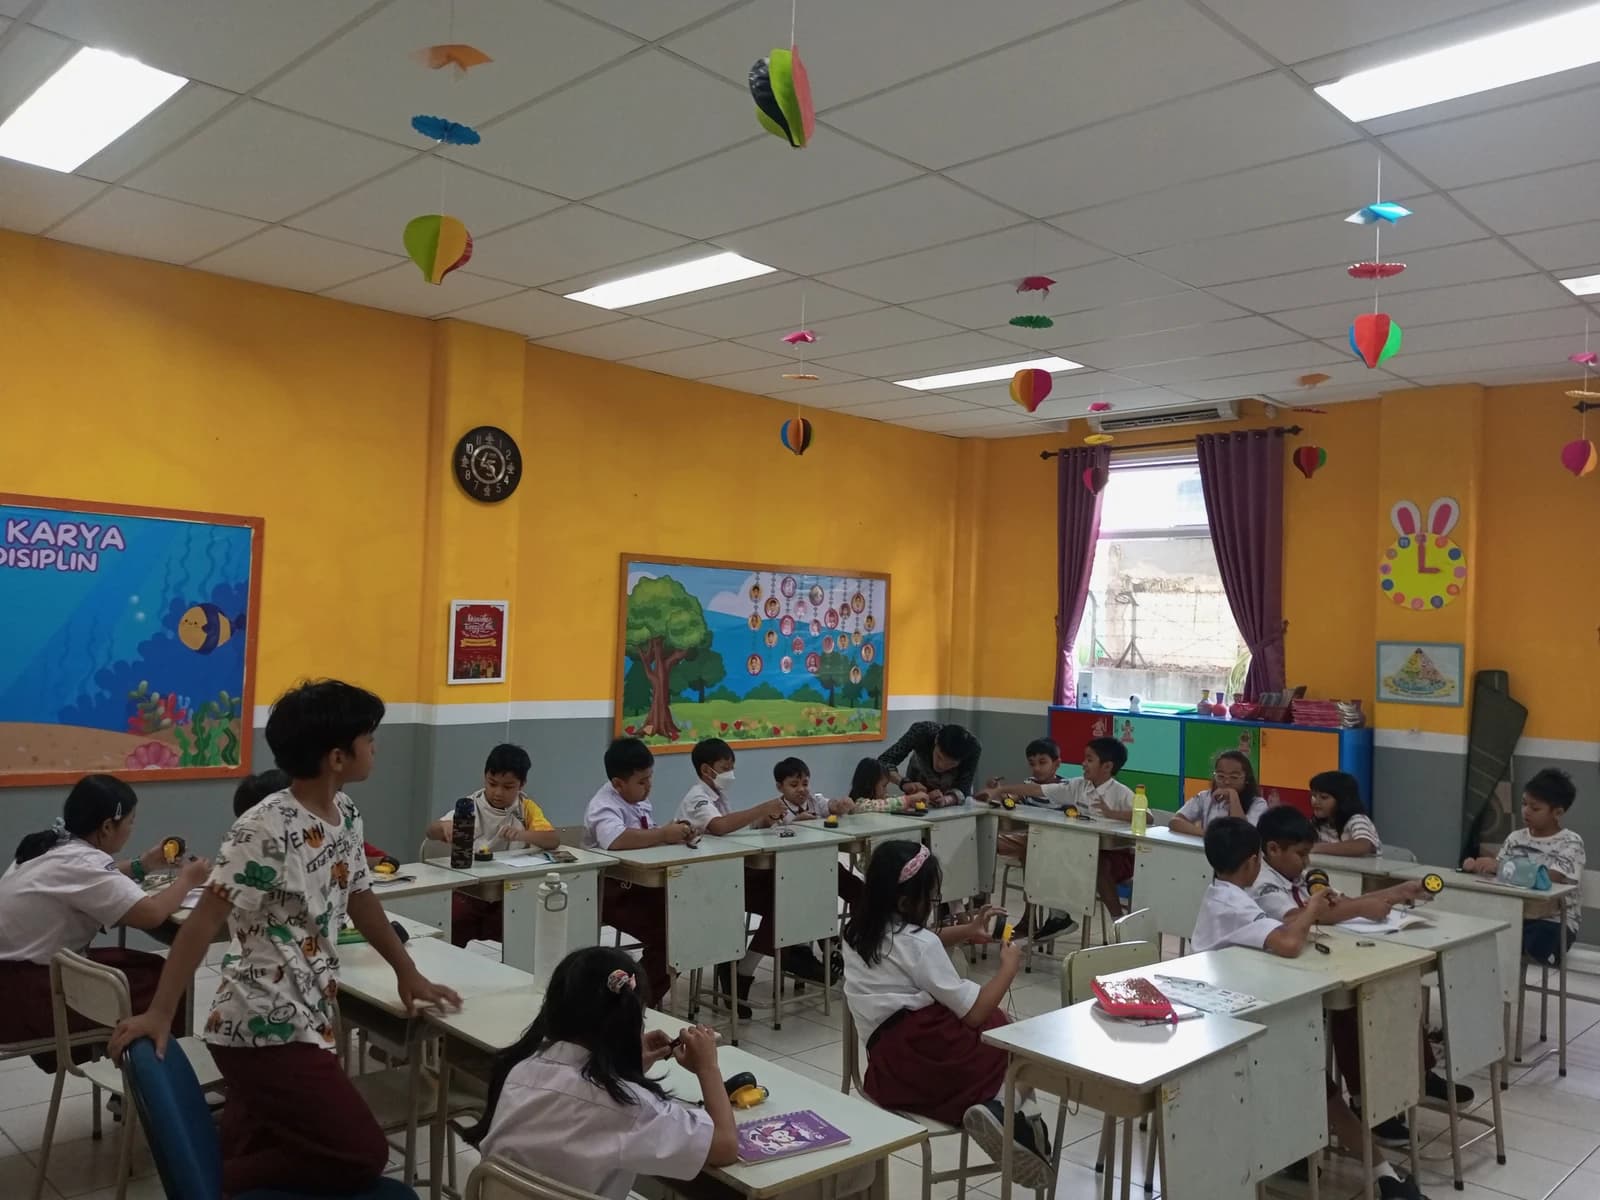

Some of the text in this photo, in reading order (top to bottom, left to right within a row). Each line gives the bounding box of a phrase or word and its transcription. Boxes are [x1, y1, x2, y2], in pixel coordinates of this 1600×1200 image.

[466, 443, 474, 454] 10
[506, 450, 512, 460] 2
[465, 470, 471, 480] 8
[504, 476, 510, 485] 4
[496, 483, 502, 493] 5
[7, 518, 125, 551] KARYA
[279, 822, 325, 857] YEAH!
